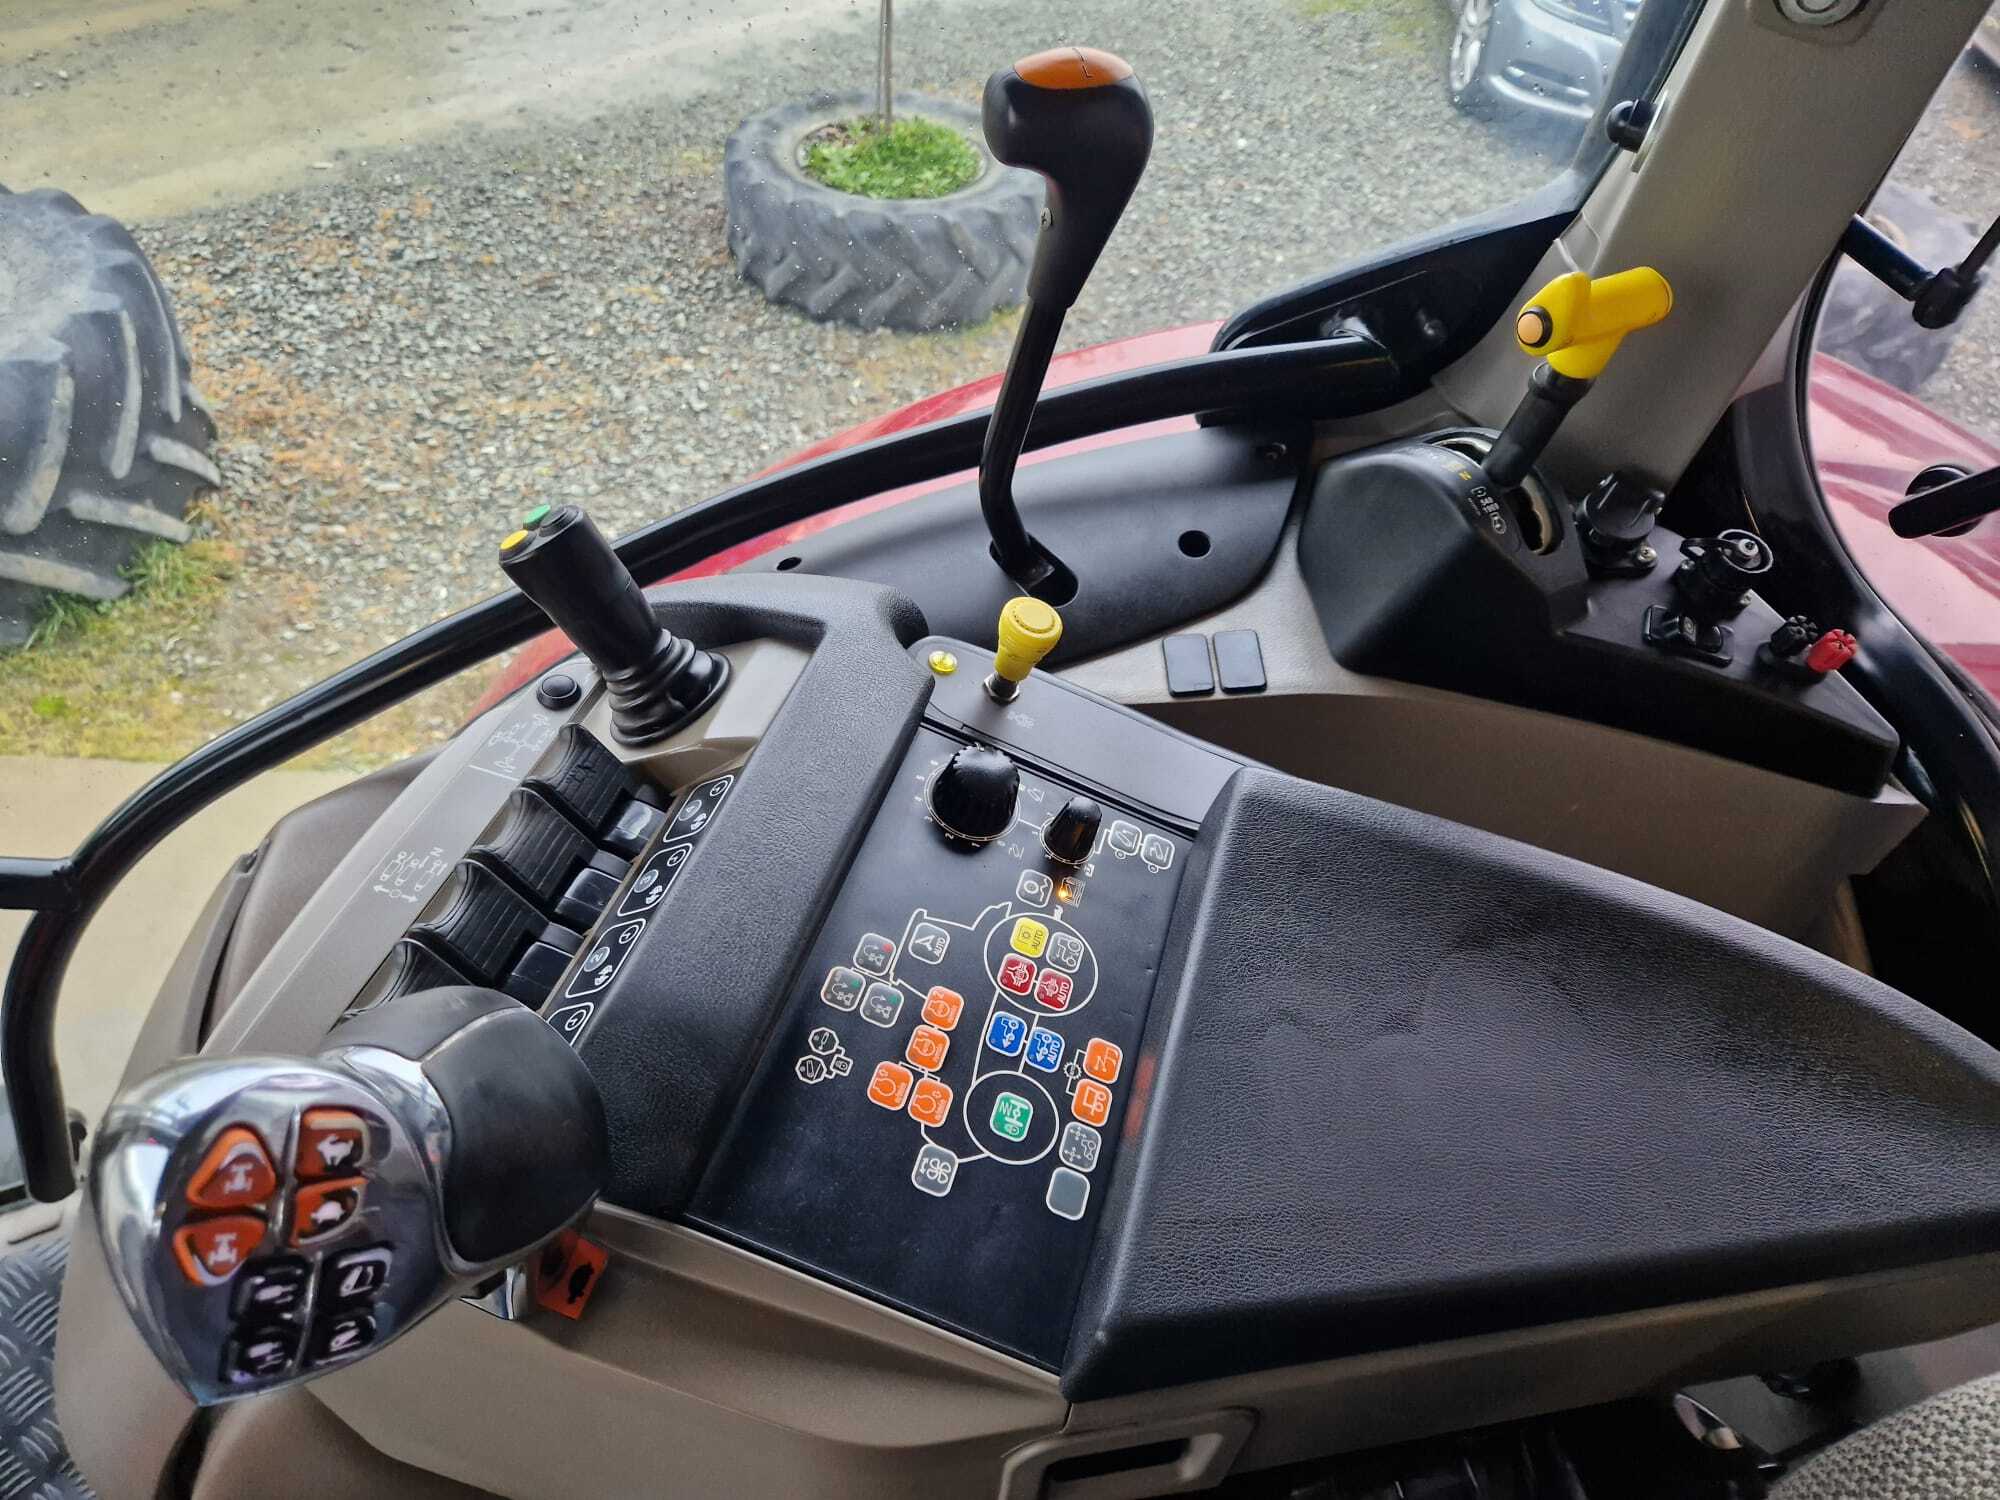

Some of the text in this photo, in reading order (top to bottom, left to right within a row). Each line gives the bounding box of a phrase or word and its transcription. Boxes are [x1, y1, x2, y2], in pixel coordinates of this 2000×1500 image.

[945, 832, 954, 840] 2
[934, 936, 946, 957] AUTO
[1032, 929, 1044, 951] AUTO
[1057, 981, 1070, 1005] AUTO
[1047, 1040, 1060, 1064] AUTO
